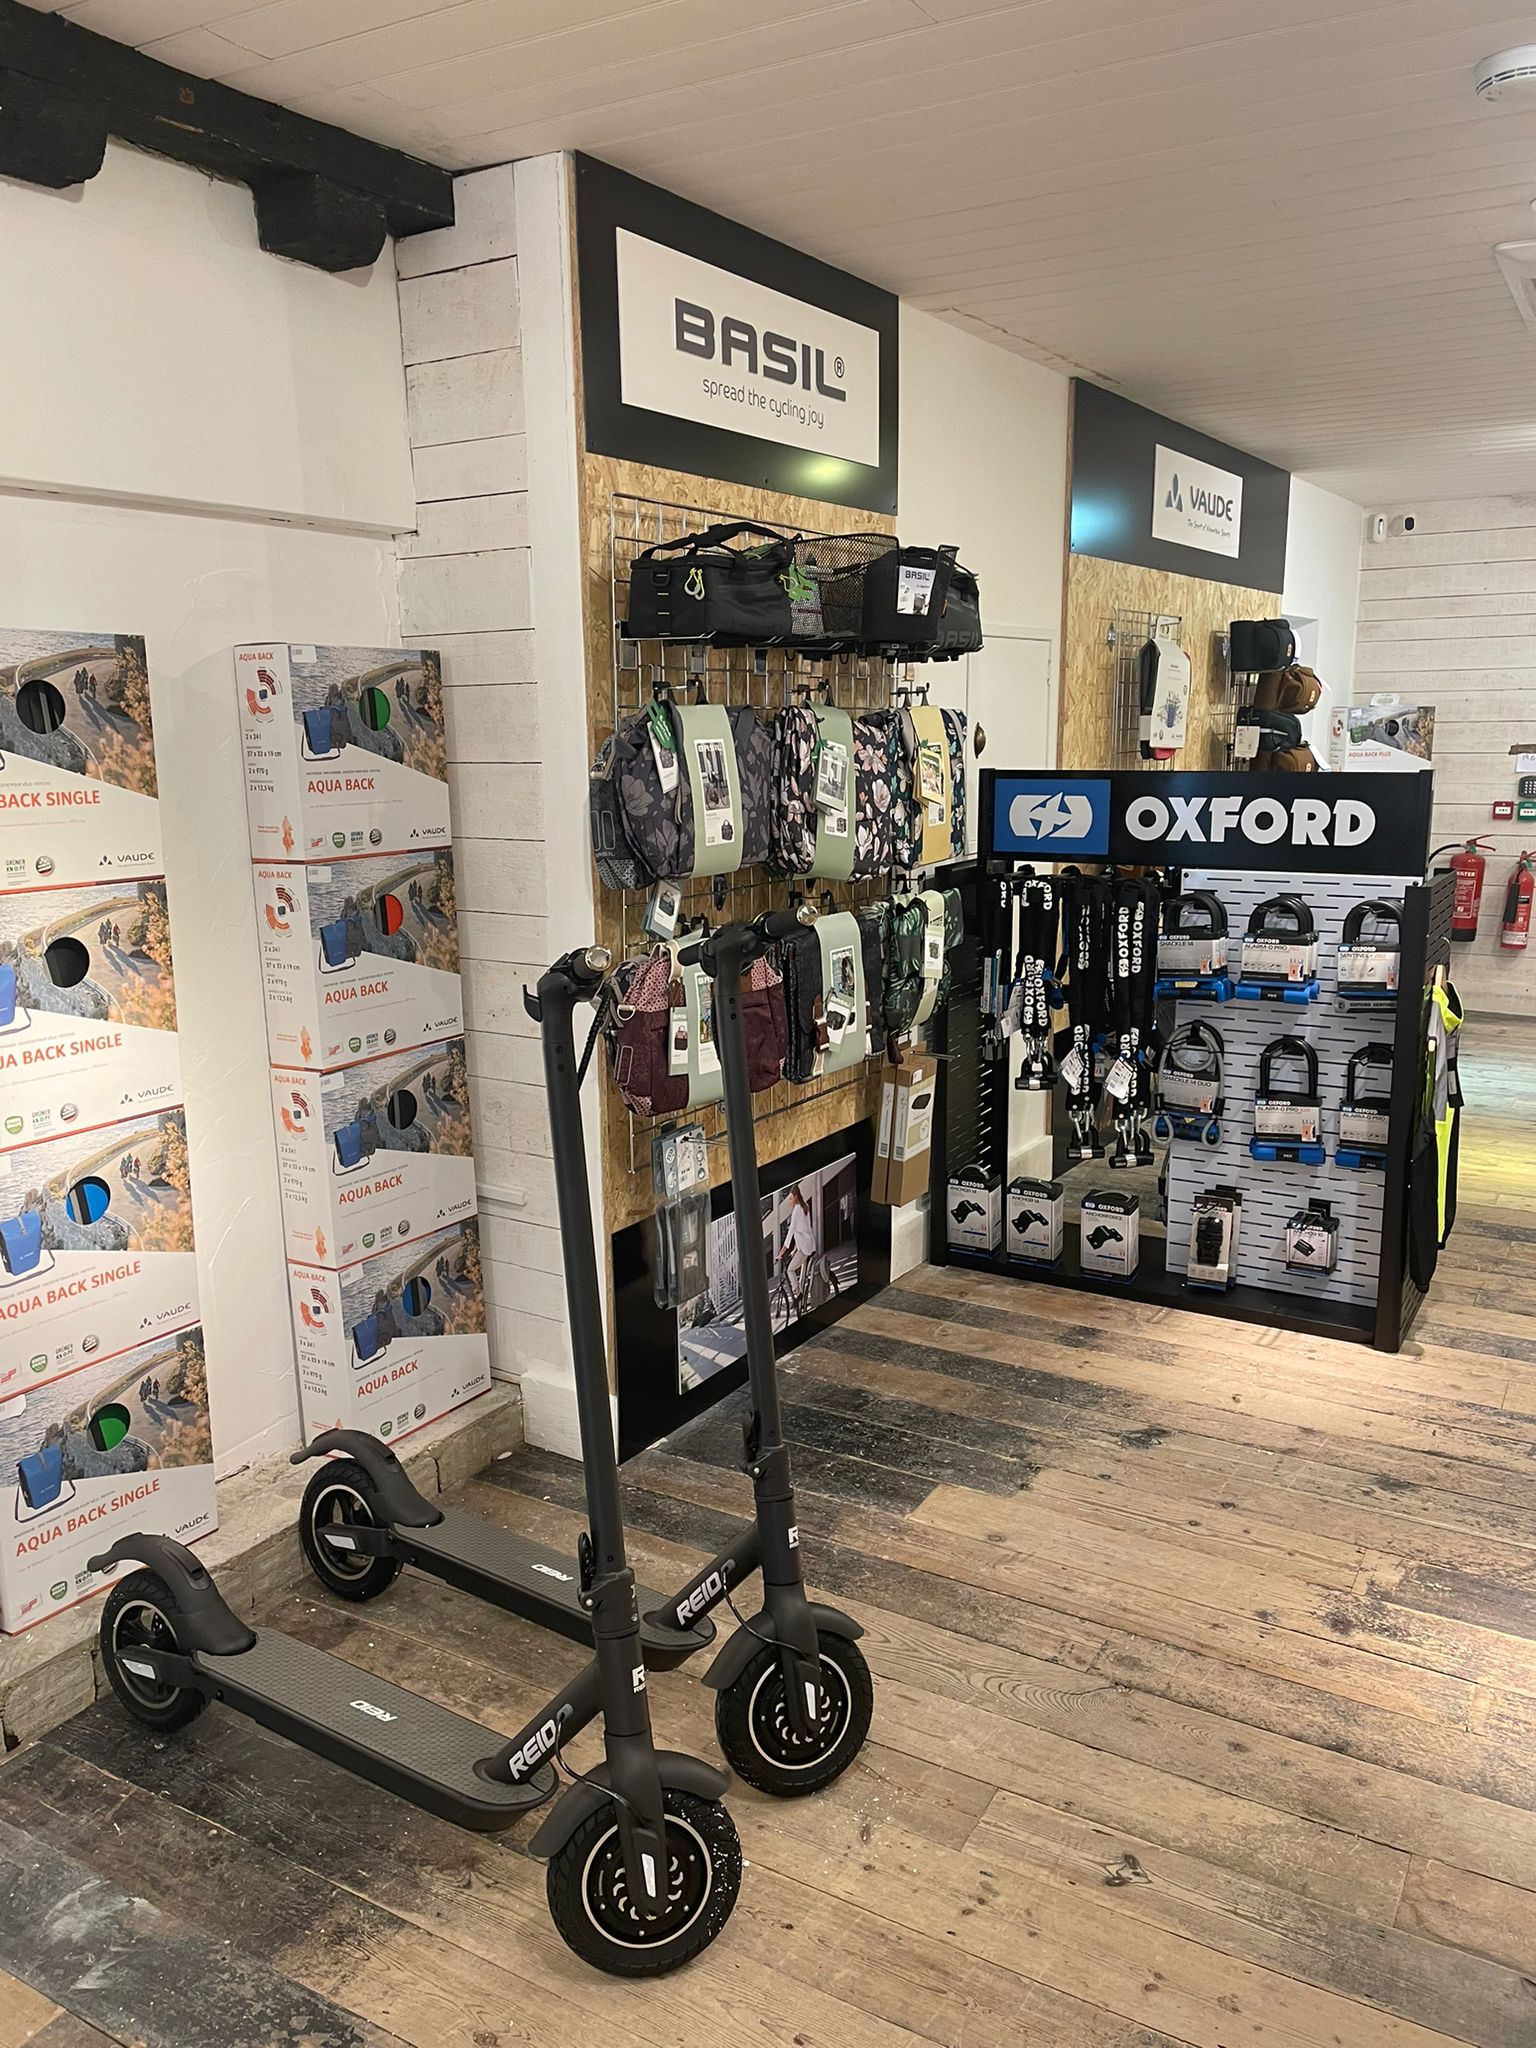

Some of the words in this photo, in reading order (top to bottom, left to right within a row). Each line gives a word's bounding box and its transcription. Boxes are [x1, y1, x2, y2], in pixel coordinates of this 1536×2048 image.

[674, 297, 846, 402] BASIL
[702, 378, 745, 403] spread
[748, 388, 766, 409] the
[769, 398, 806, 424] cycling
[806, 404, 824, 429] joy
[1190, 485, 1234, 521] VAUDE
[904, 570, 931, 581] BASIL
[239, 653, 256, 661] AQUA
[257, 652, 274, 660] BACK
[46, 790, 100, 806] SINGLE
[307, 780, 342, 795] AQUA
[345, 778, 375, 791] BACK
[422, 826, 447, 836] VAUDE
[1125, 795, 1376, 847] OXFORD
[117, 852, 155, 864] VAUDE
[258, 871, 275, 879] AQUA
[276, 871, 292, 879] BACK
[1118, 906, 1130, 958] OXFORD
[1131, 920, 1144, 974] OXFORD
[324, 987, 358, 1004] AQUA
[360, 980, 389, 997] BACK
[698, 977, 714, 985] BAS
[1034, 978, 1048, 1027] OXFORD
[23, 1043, 66, 1065] BACK
[70, 1033, 123, 1056] SINGLE
[138, 1084, 175, 1099] VAUDE
[338, 1185, 372, 1205] AQUA
[375, 1174, 403, 1193] BACK
[961, 1180, 985, 1189] OXFORD
[1023, 1189, 1048, 1199] OXFORD
[1097, 1203, 1125, 1213] OXFORD
[47, 1279, 88, 1305] BACK
[91, 1260, 142, 1290] SINGLE
[156, 1302, 191, 1321] VAUDE
[357, 1374, 389, 1398] AQUA
[391, 1359, 419, 1382] BACK
[15, 1526, 62, 1557] AQUA
[67, 1503, 107, 1533] BACK
[111, 1478, 161, 1511] SINGLE
[174, 1512, 210, 1534] VAUDE
[531, 1563, 574, 1582] REID
[676, 1571, 723, 1626] REID
[350, 1699, 398, 1722] REID
[509, 1717, 557, 1781] REID
